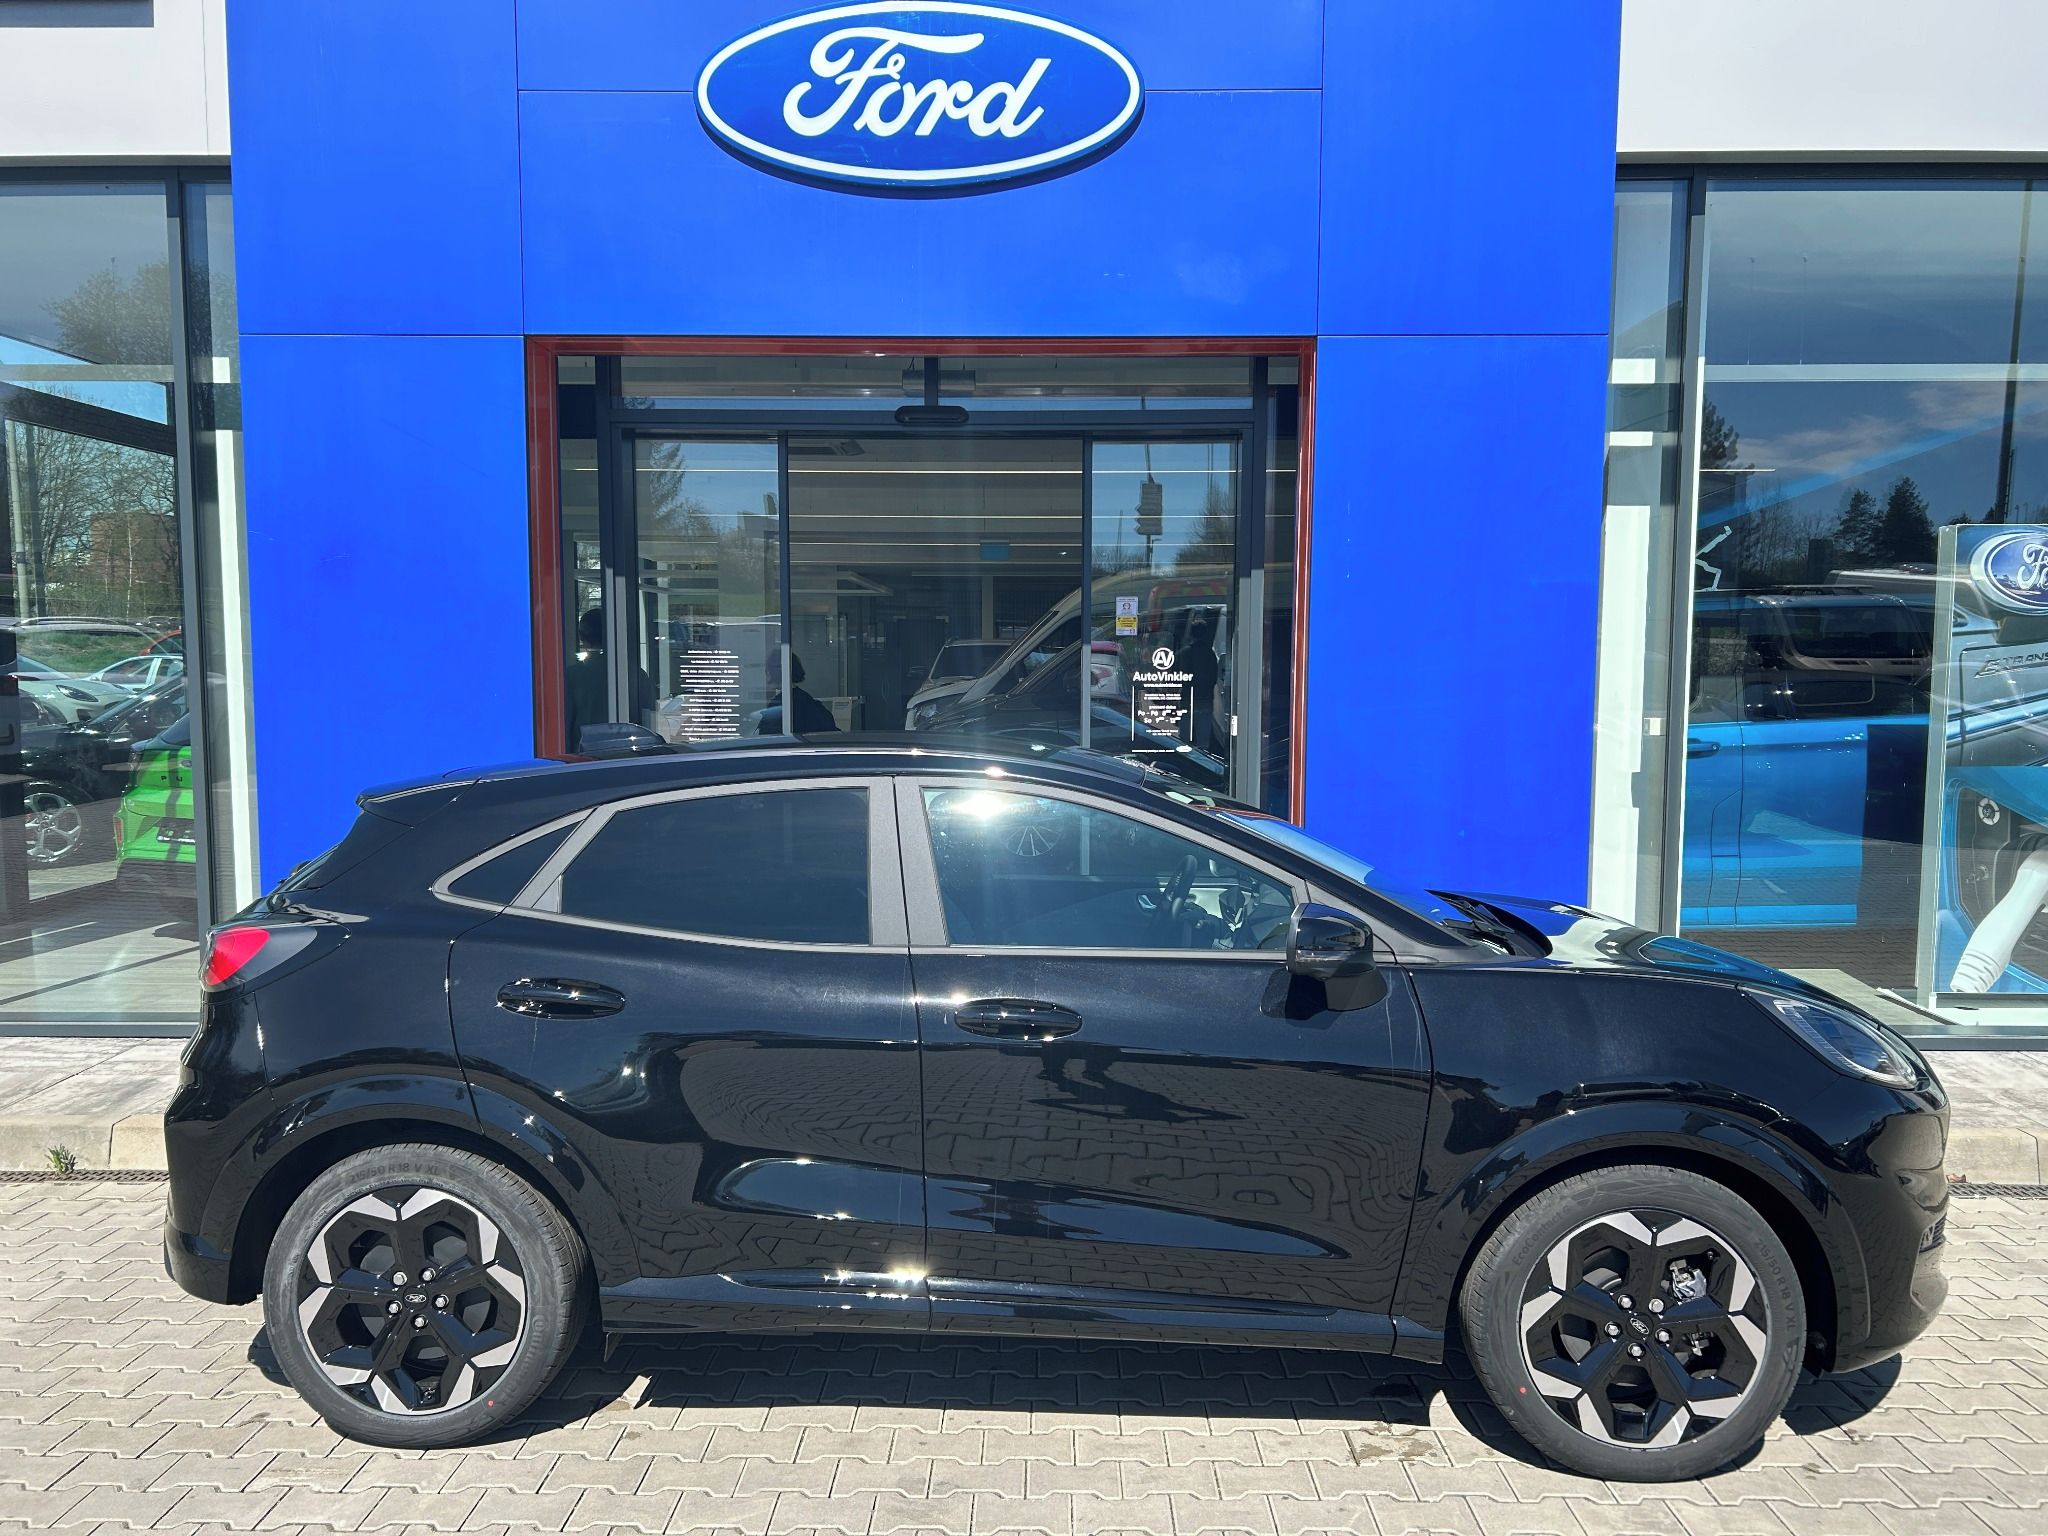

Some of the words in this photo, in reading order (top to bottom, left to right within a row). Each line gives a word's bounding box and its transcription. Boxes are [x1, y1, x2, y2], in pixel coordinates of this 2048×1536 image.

[783, 27, 1052, 138] Ford
[1132, 671, 1193, 681] AutoVinkler
[1512, 1211, 1562, 1265] EcoContact
[1755, 1239, 1781, 1275] 215/50
[1785, 1303, 1794, 1311] V
[1786, 1316, 1796, 1331] XL
